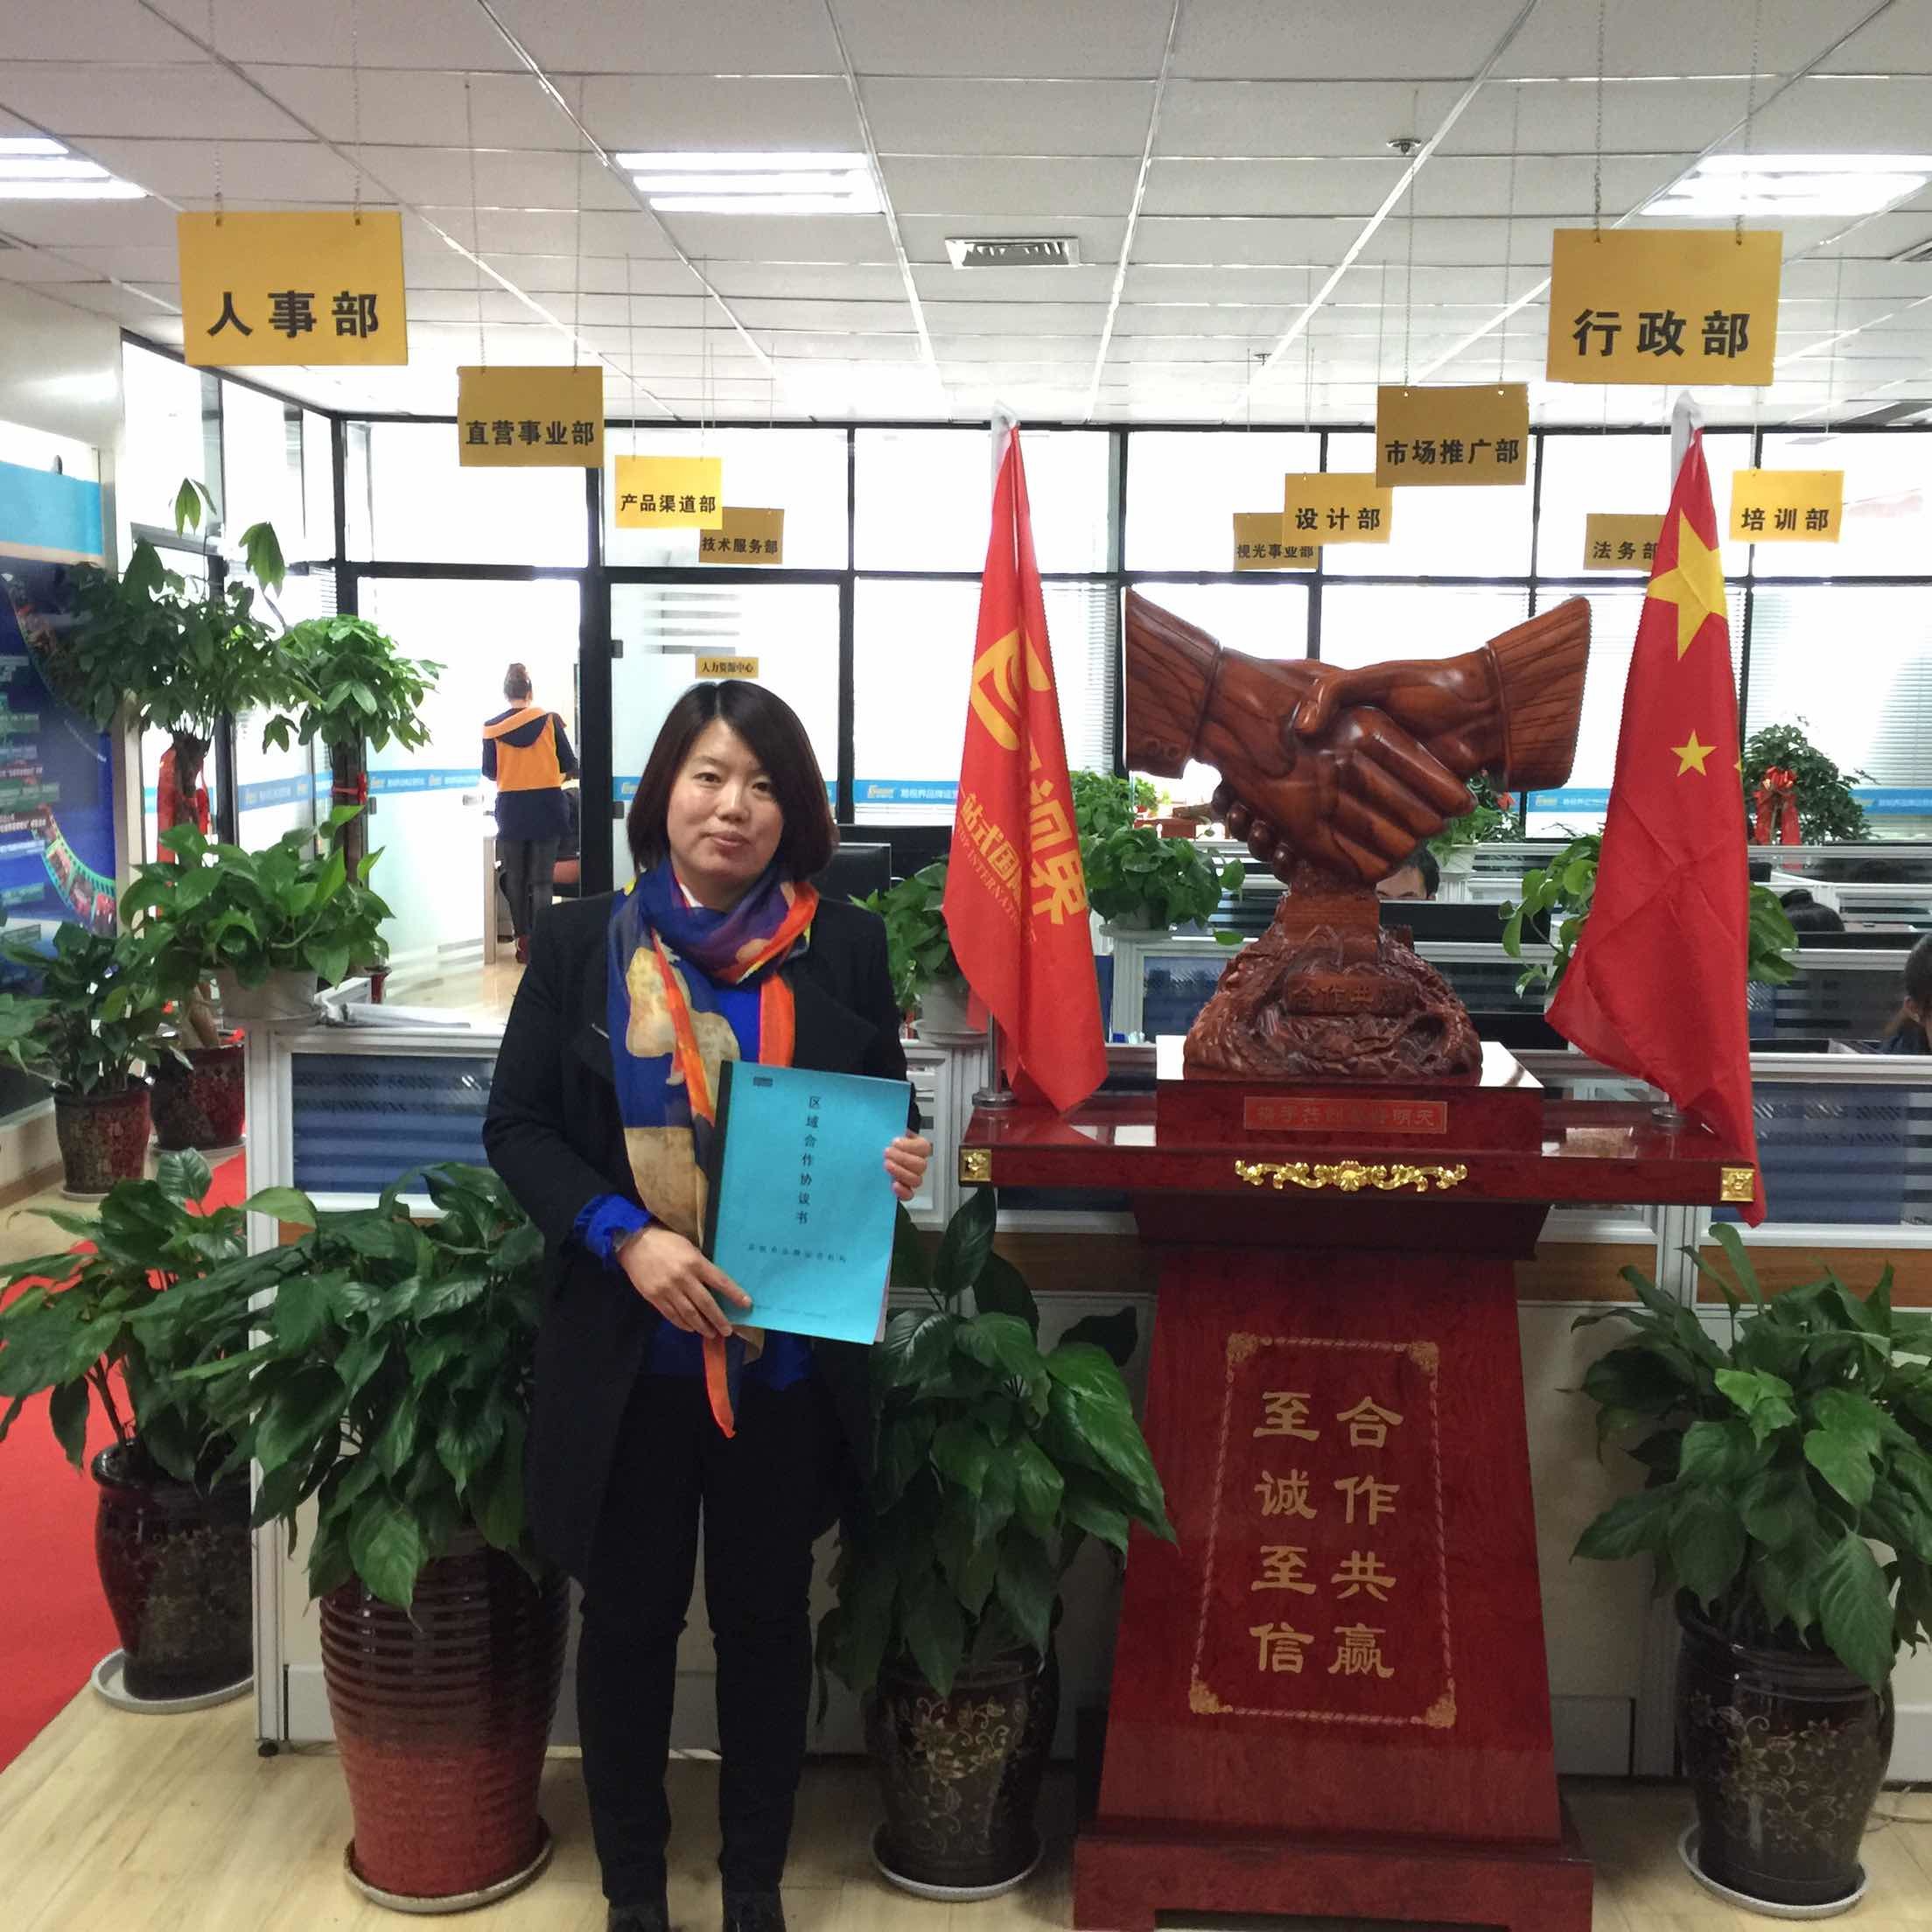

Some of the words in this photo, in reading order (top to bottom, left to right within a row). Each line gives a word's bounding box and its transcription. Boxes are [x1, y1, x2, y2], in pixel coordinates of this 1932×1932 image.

[206, 290, 379, 339] 人事部
[1572, 309, 1751, 358] 行政部
[465, 420, 595, 446] 直营事业部
[1384, 438, 1520, 466] 市场推广部
[620, 493, 716, 514] 产品渠道部
[1294, 507, 1381, 531] 设计部
[1740, 508, 1830, 532] 培训部
[702, 536, 778, 555] 技术服务部
[1236, 543, 1314, 559] 视光事业部
[1592, 541, 1657, 560] 法务部
[795, 1096, 822, 1226] 区域合作协议书
[1249, 1391, 1320, 1674] 至诚至信
[1327, 1396, 1404, 1679] 合作共赢
